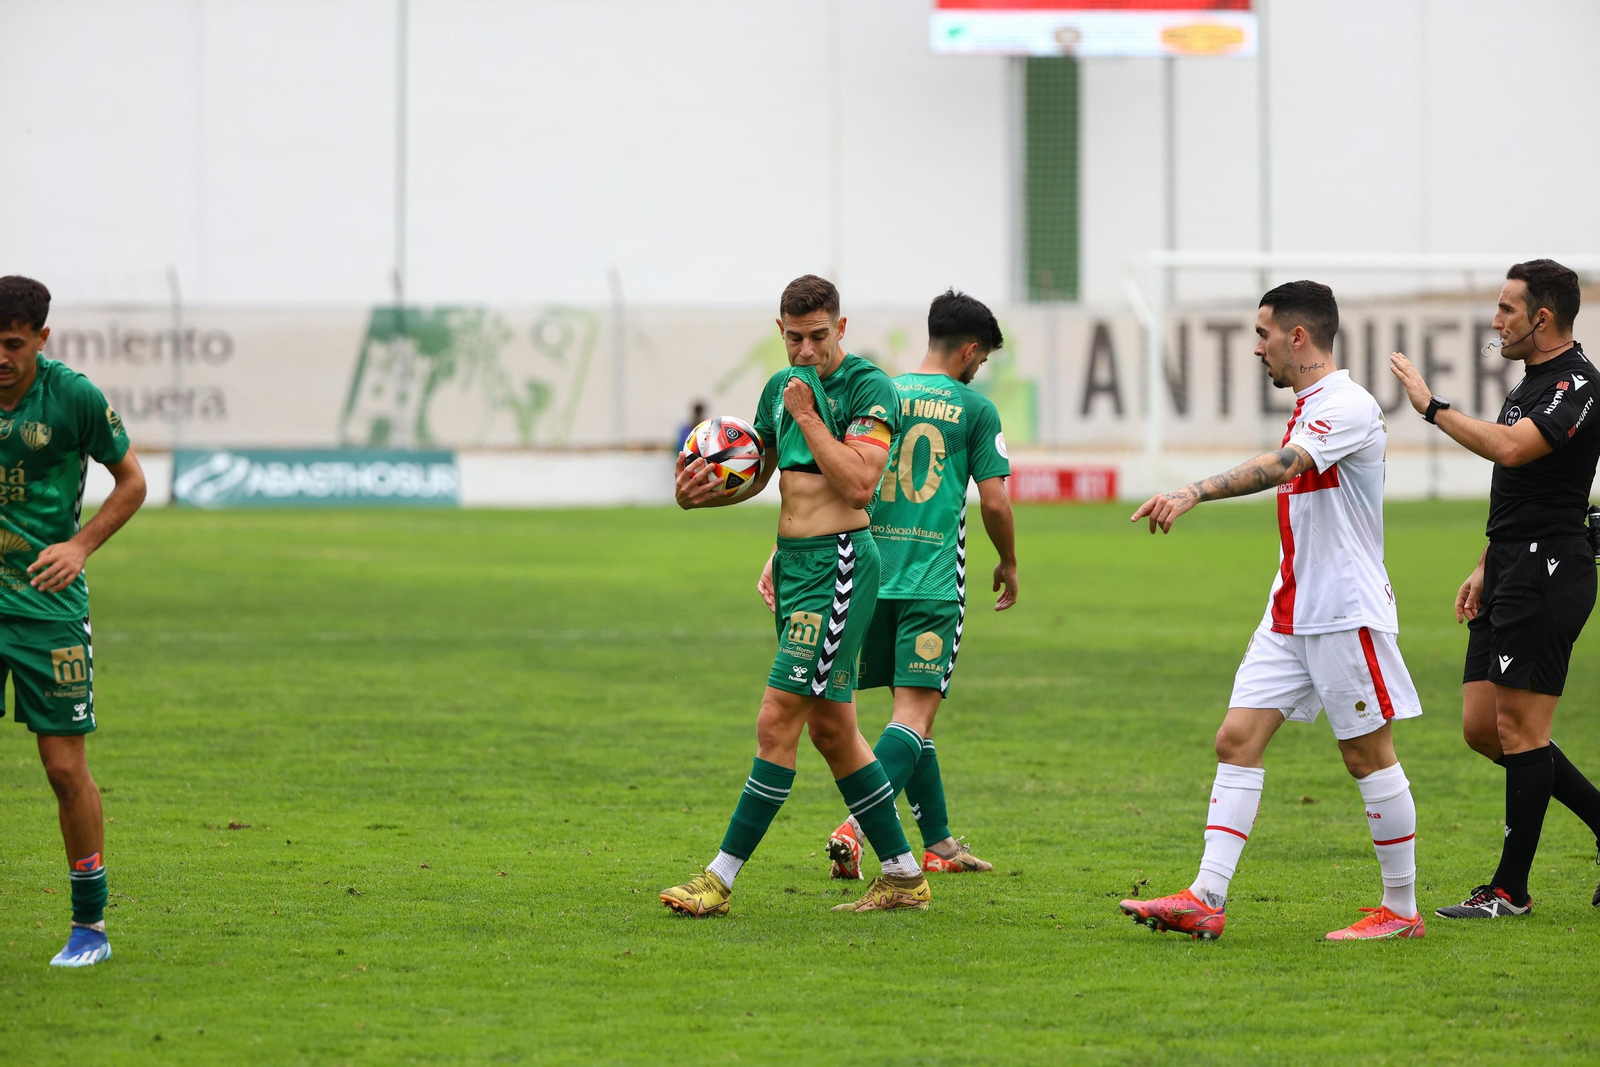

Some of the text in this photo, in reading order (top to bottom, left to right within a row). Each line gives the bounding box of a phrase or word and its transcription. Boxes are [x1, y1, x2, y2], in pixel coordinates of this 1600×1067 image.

[913, 398, 963, 424] NÚÑEZ
[886, 525, 911, 535] SANCHO
[912, 527, 944, 540] MELERO
